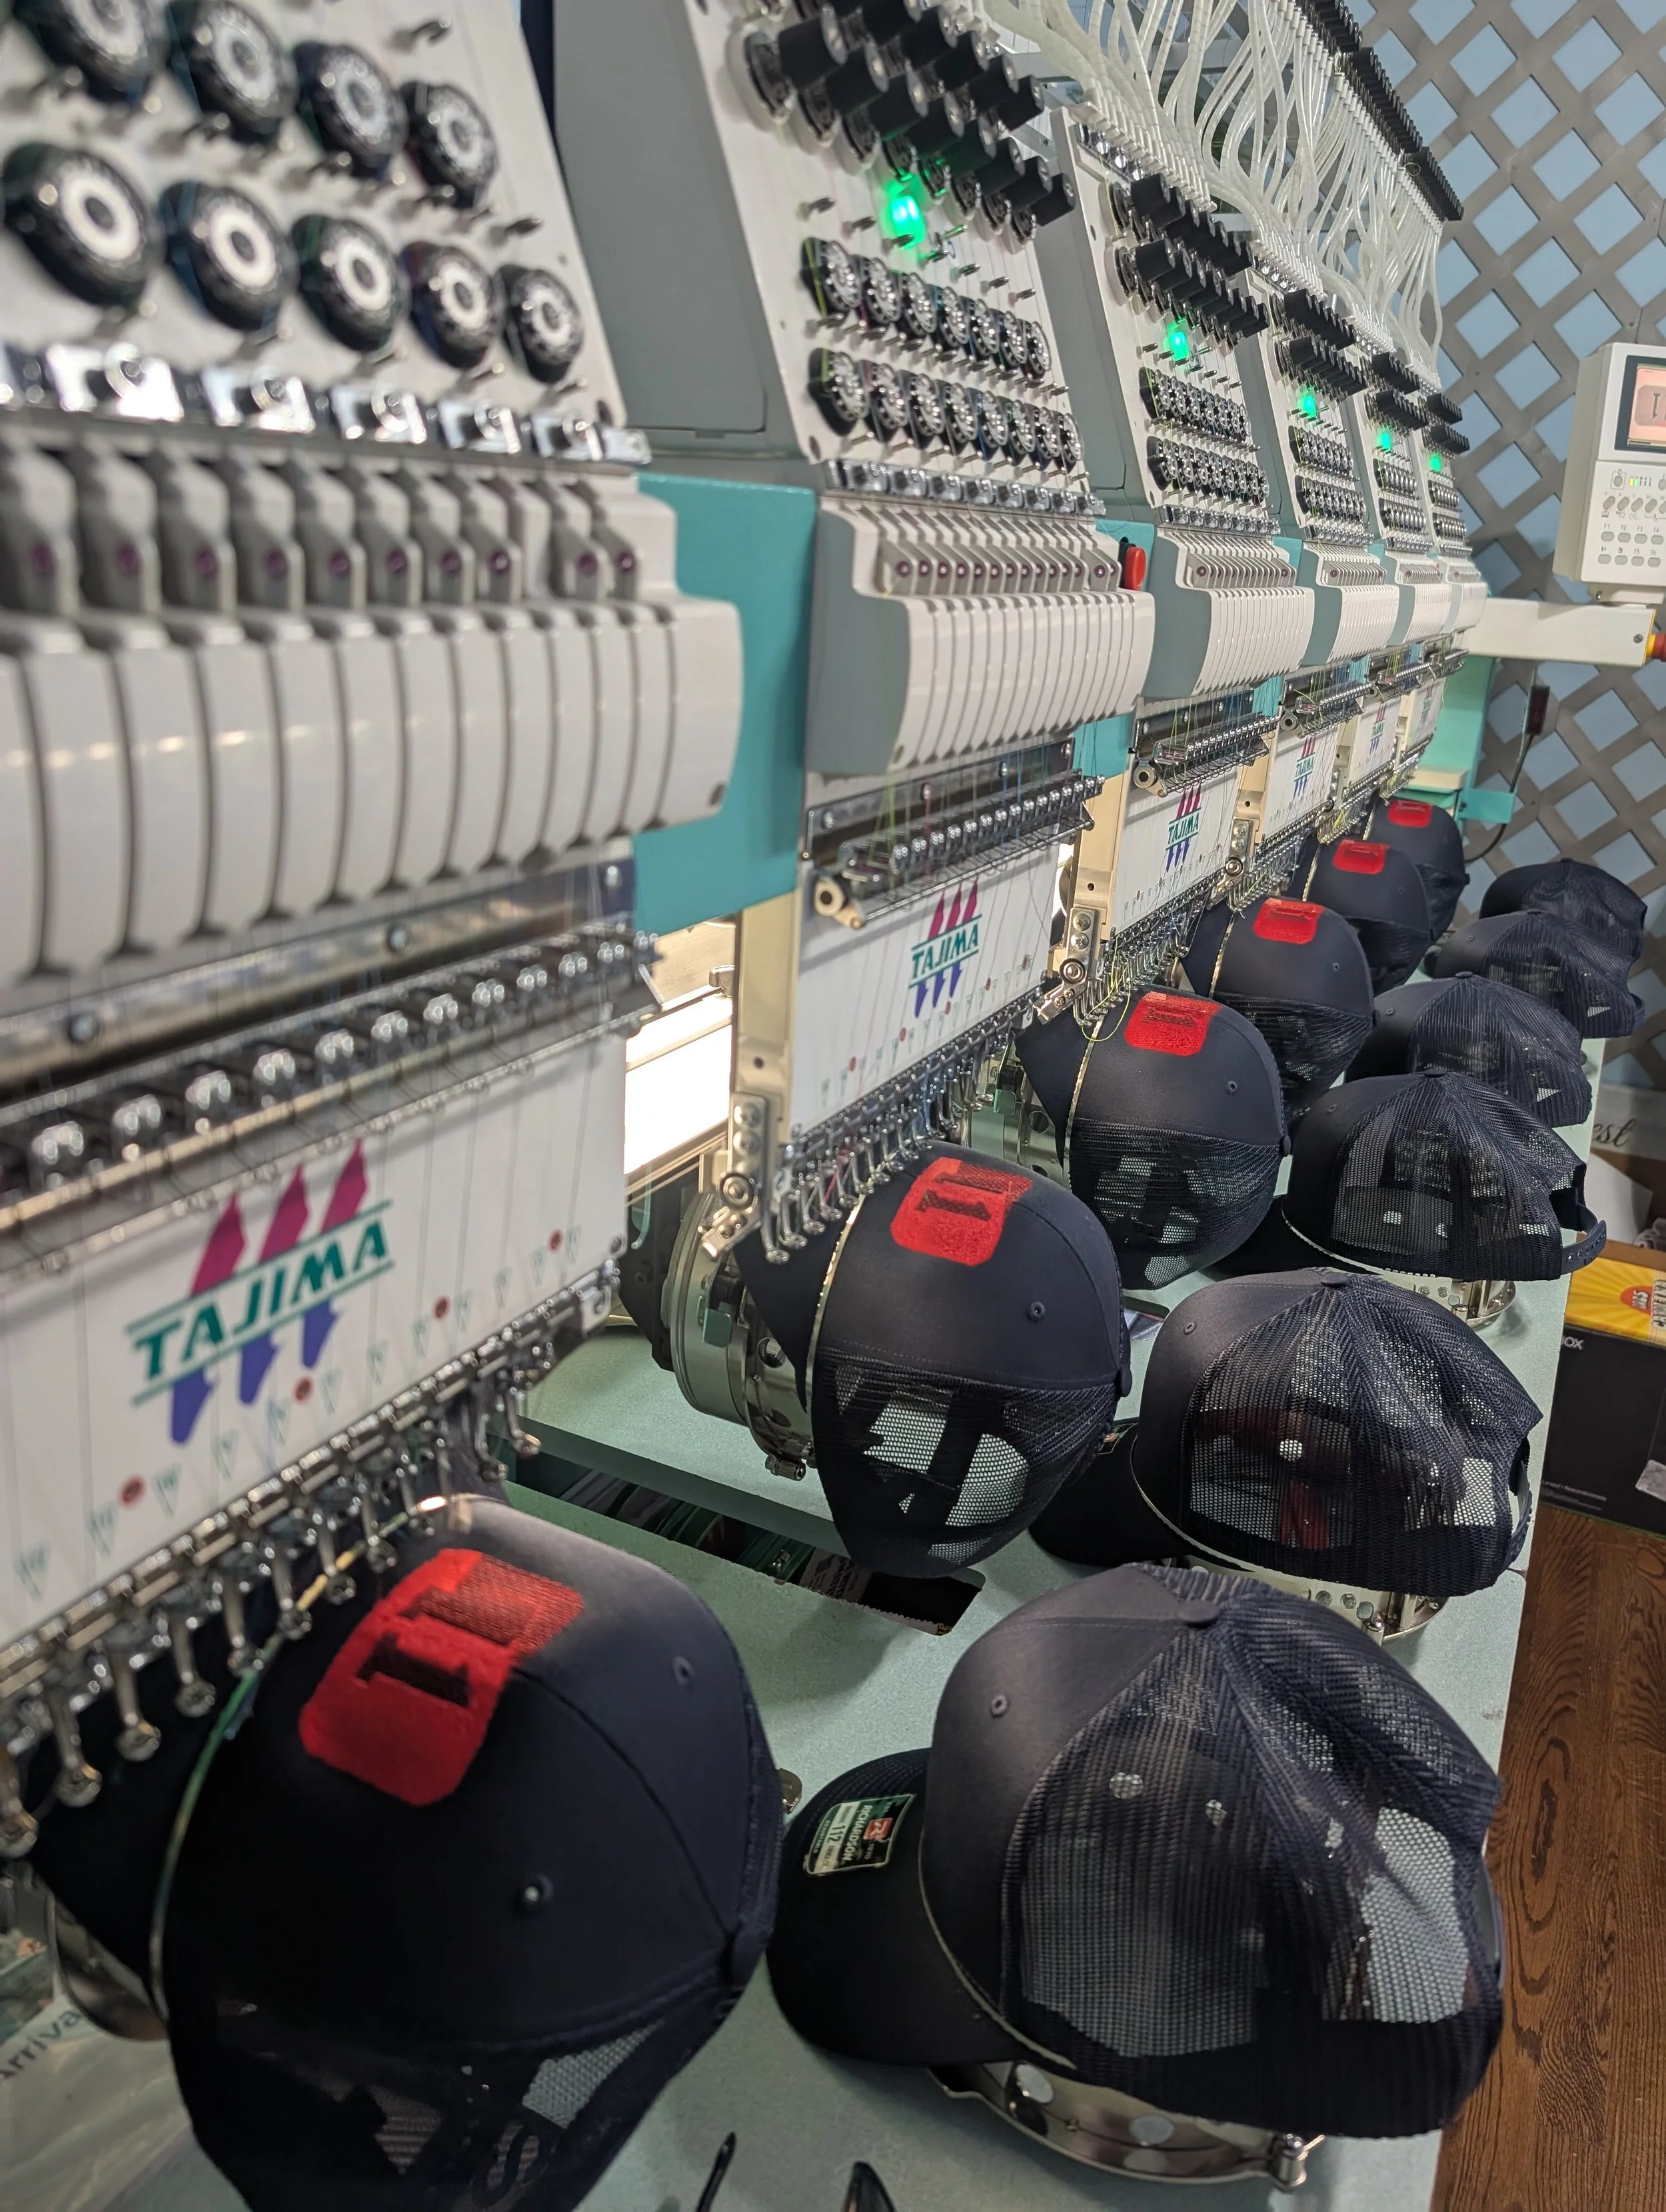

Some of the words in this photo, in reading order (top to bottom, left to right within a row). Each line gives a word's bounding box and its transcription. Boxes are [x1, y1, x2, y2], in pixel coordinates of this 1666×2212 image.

[1167, 812, 1200, 845] TAJIMA
[911, 923, 980, 979] TAJIMA
[134, 1221, 387, 1381] TAJIMA
[826, 1826, 846, 1843] 112
[842, 1804, 873, 1861] RICHARDSON
